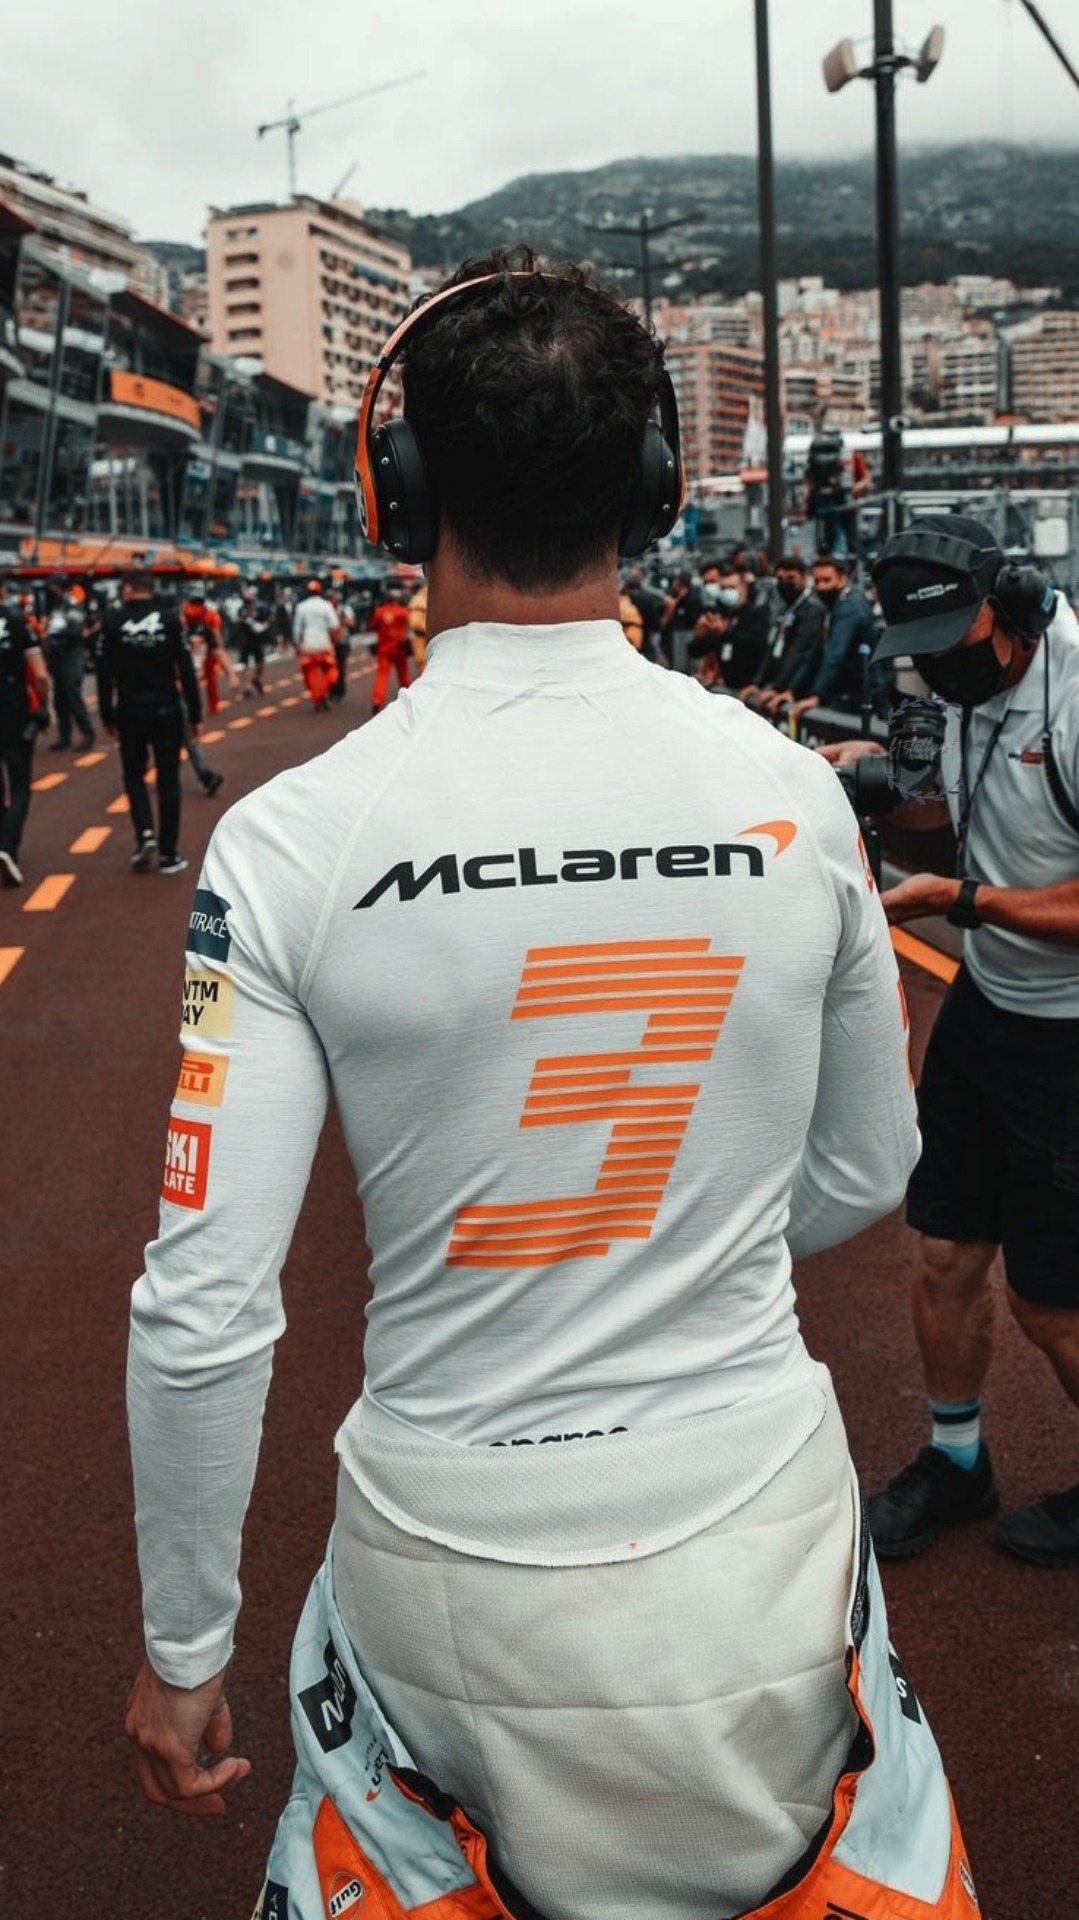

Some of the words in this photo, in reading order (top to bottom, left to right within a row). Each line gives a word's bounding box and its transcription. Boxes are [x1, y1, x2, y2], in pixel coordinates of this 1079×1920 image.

[352, 843, 765, 910] McLaren
[445, 938, 746, 1267] 3
[330, 1880, 362, 1915] Gulf
